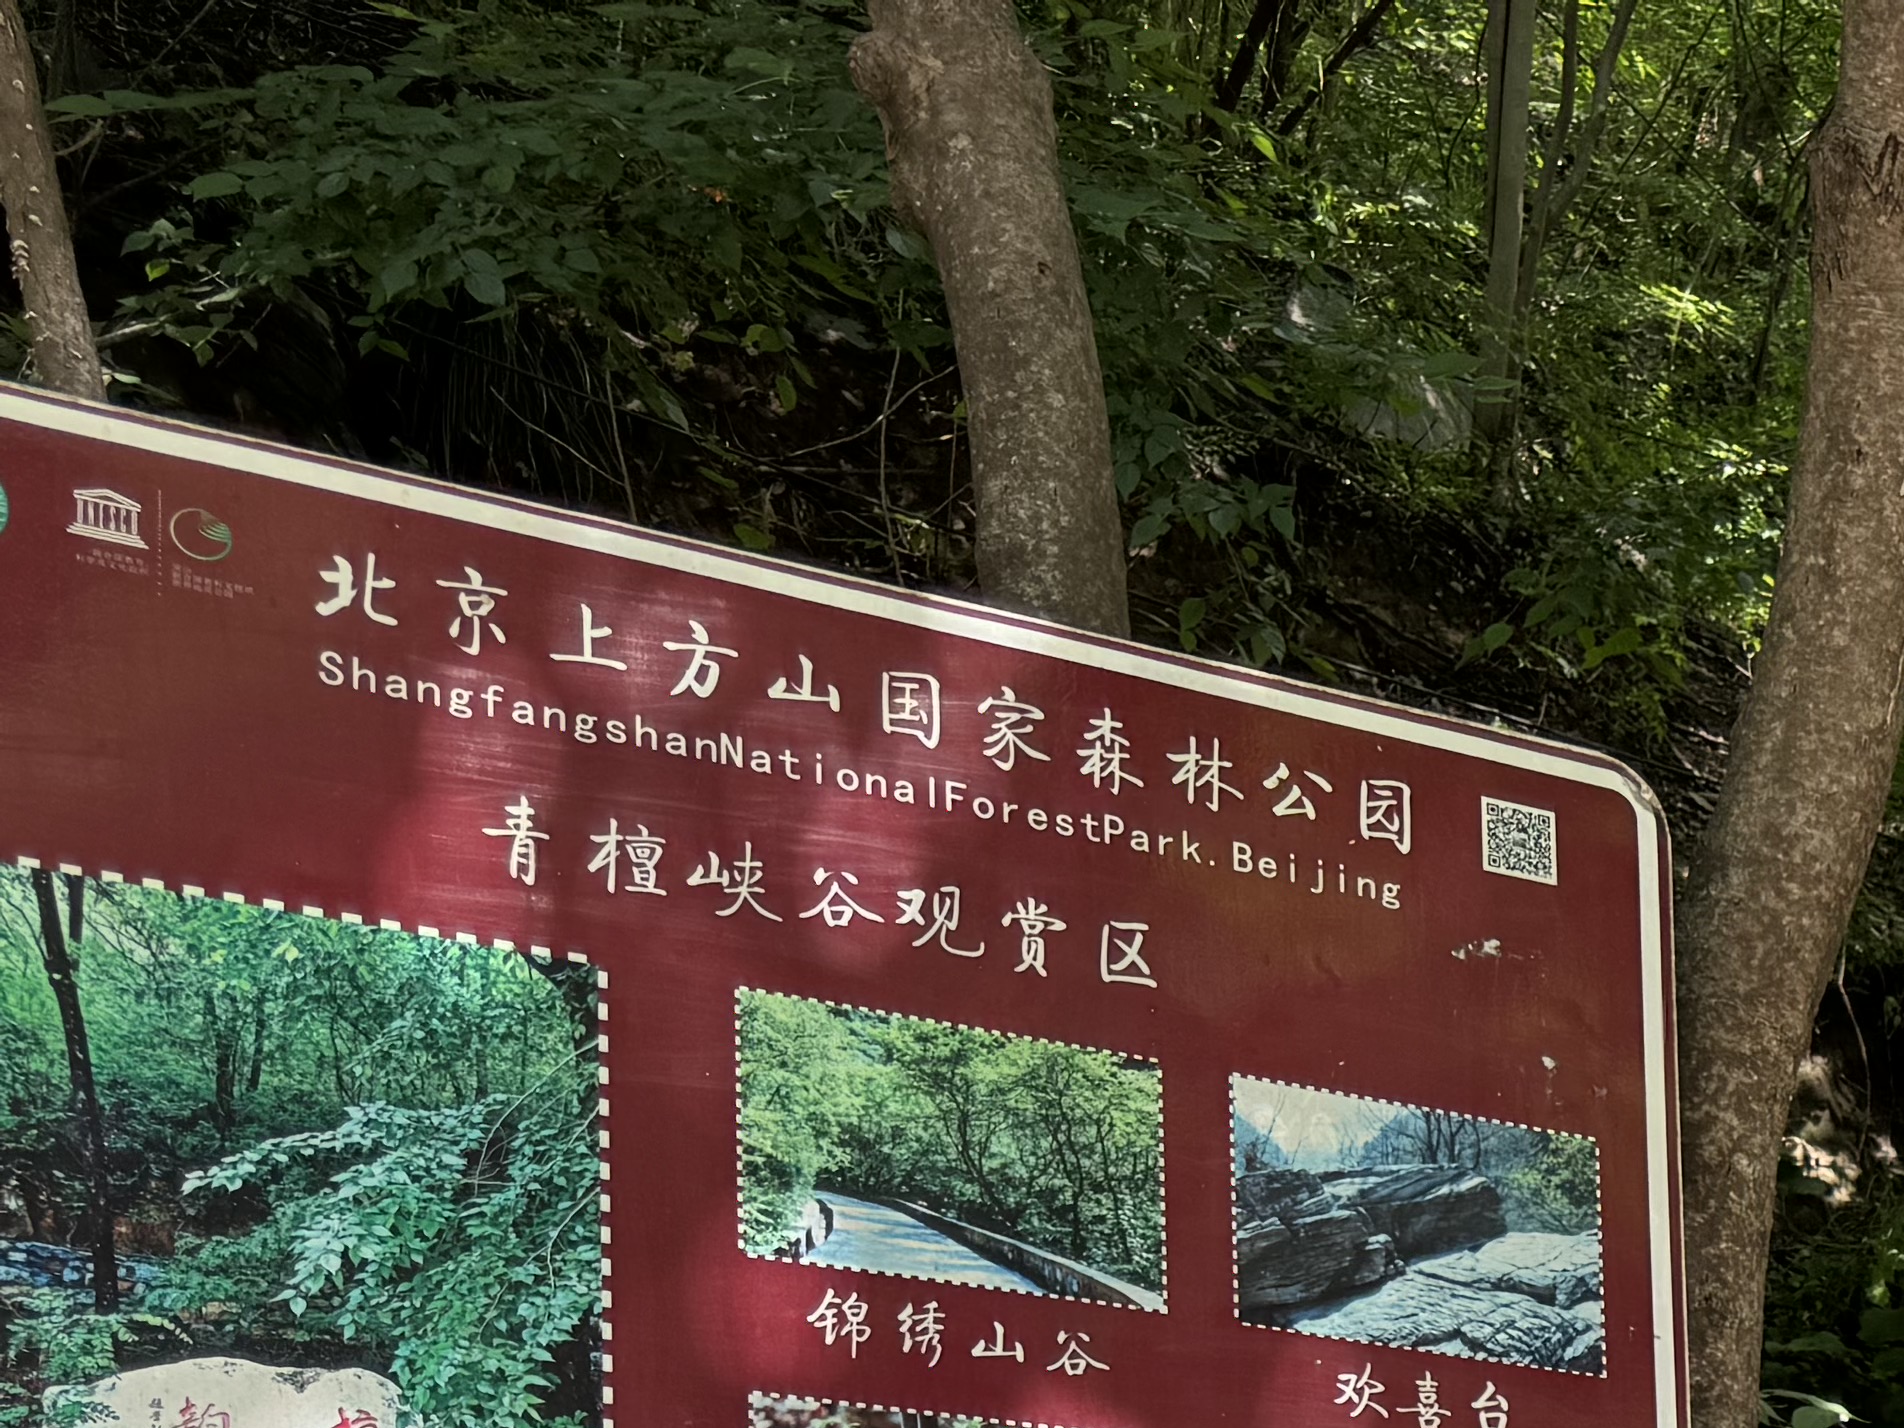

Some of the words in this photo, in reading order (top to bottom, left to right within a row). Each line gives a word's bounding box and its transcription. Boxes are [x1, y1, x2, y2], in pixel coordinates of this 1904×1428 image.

[314, 552, 1412, 855] 北京上方山国家森林公园
[318, 648, 1401, 910] ShangfangshanNationalForestPark.Beijing
[481, 793, 1158, 989] 青檀峡谷观赏区
[806, 1287, 1111, 1376] 锦绣山谷
